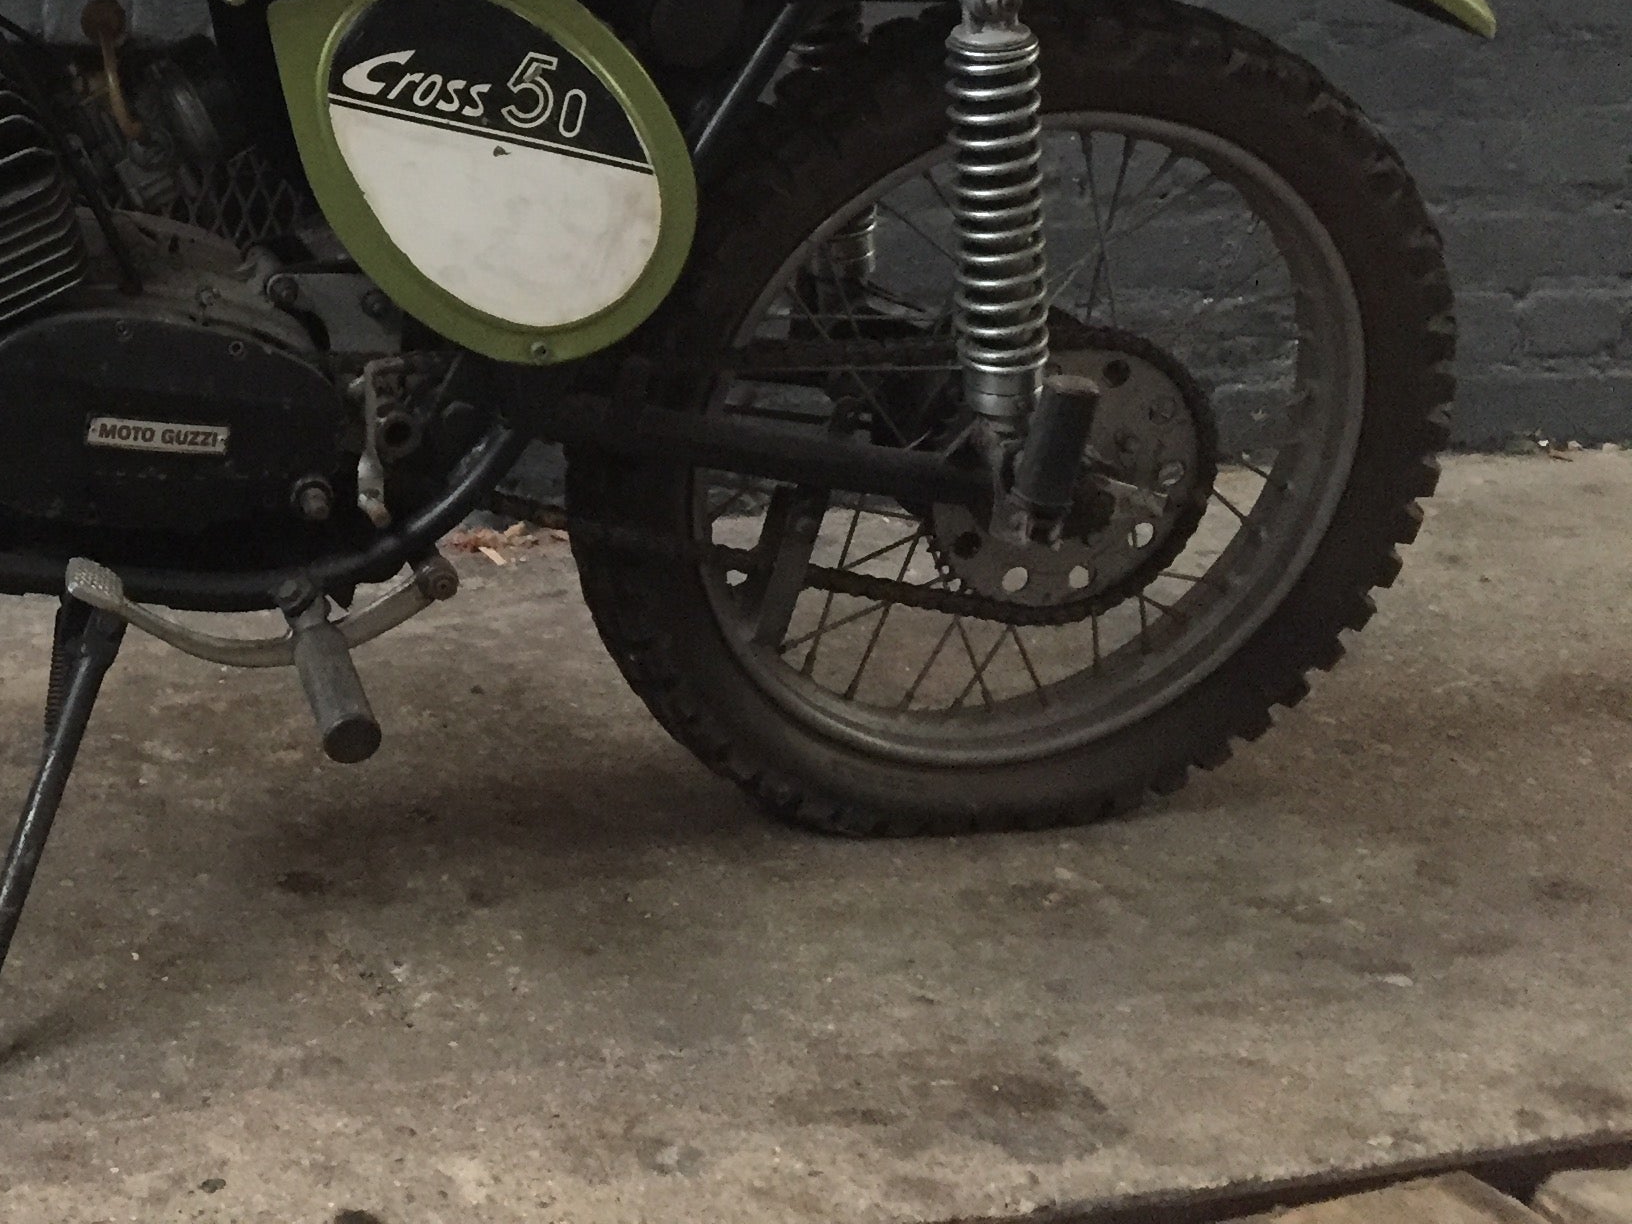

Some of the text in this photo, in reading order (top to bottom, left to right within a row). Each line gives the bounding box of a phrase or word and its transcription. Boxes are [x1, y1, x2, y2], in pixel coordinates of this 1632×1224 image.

[342, 49, 587, 138] Cross 50
[98, 423, 218, 448] MOTO GUZZI
